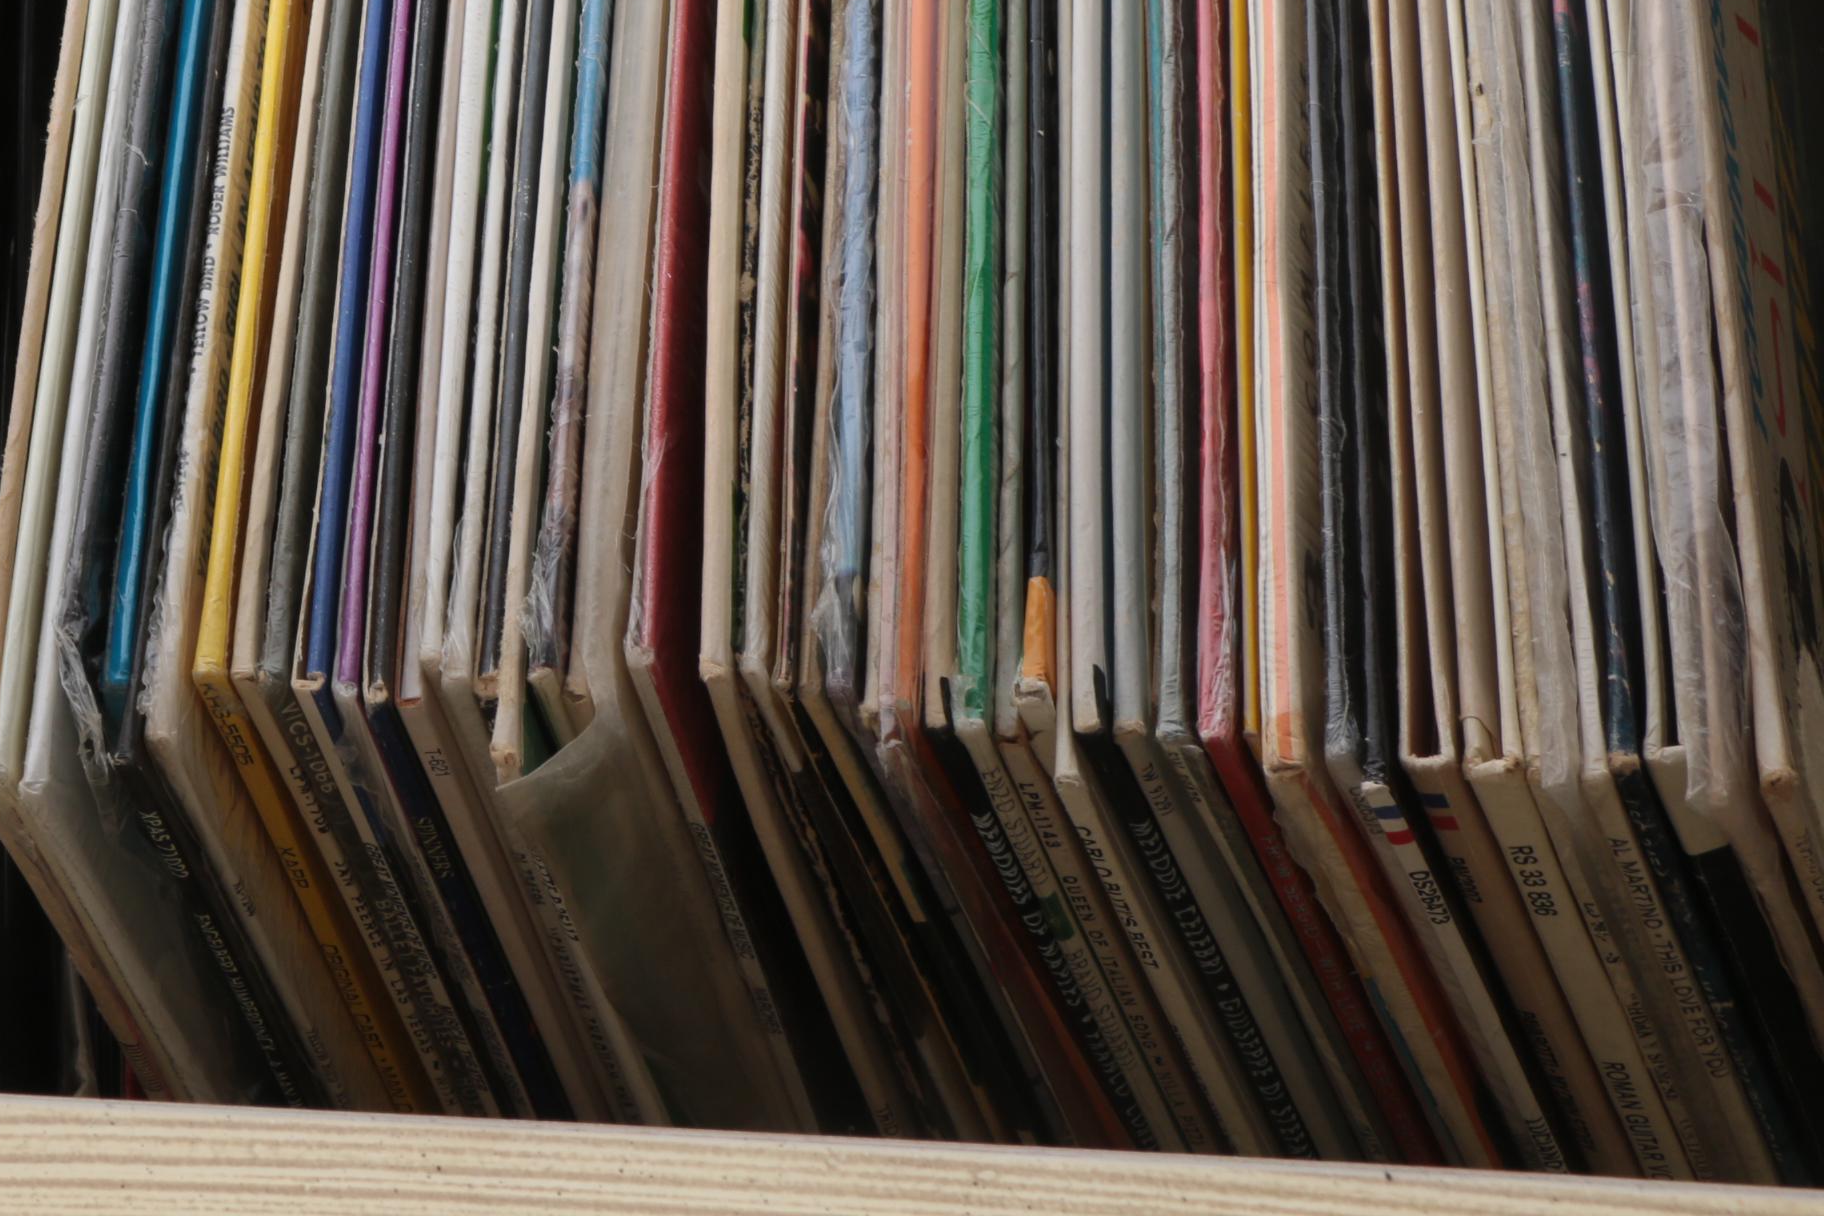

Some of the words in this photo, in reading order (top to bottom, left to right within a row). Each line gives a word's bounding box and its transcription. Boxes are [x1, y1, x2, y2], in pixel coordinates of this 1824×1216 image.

[213, 106, 236, 178] WILLIAMS
[206, 189, 226, 236] ROGER
[200, 257, 217, 292] BIRD
[190, 303, 212, 357] YELLOW
[423, 748, 451, 776] T-621
[416, 815, 457, 882] SPINNERS
[689, 825, 719, 865] GREAT
[1073, 824, 1112, 880] CARLO
[1509, 845, 1538, 865] RS
[1610, 838, 1630, 855] AL
[277, 704, 337, 796] VICS-1066
[371, 899, 416, 960] BALLET
[402, 965, 459, 1052] FAVORITES
[1519, 869, 1547, 888] 33
[1622, 859, 1664, 933] MARTINO
[724, 912, 743, 929] OF
[978, 770, 1015, 817] ENZO
[1001, 821, 1049, 889] STUARTI
[1064, 951, 1104, 1003] BRAVO
[1091, 1007, 1139, 1074] STUARTI
[1015, 782, 1063, 852] LPM-1143
[1060, 875, 1096, 924] QUEEN
[1087, 929, 1109, 950] OF
[1099, 956, 1139, 1011] ITALIAN
[1128, 1015, 1158, 1051] SONG
[1527, 891, 1558, 918] 836
[1021, 911, 1050, 940] OF
[278, 847, 310, 892] KAPP
[318, 944, 363, 1009] ORIGINAL
[352, 1013, 385, 1055] CAST
[332, 861, 356, 889] JAN
[348, 896, 386, 951] PEERCE
[378, 957, 396, 973] IN
[388, 980, 412, 1007] LAS
[404, 1015, 435, 1057] VEGAS
[730, 930, 758, 963] MUSIC
[1125, 820, 1188, 905] MELODIE
[1171, 908, 1226, 979] CELEBRI
[1215, 997, 1278, 1082] GIUSEPPE
[1258, 1081, 1287, 1106] DI
[1656, 939, 1683, 976] THIS
[1672, 979, 1702, 1015] LOVE
[1689, 1014, 1716, 1049] FOR
[1701, 1053, 1729, 1079] YOU
[1603, 1060, 1641, 1118] ROMAN
[1625, 1114, 1665, 1170] GUITAR
